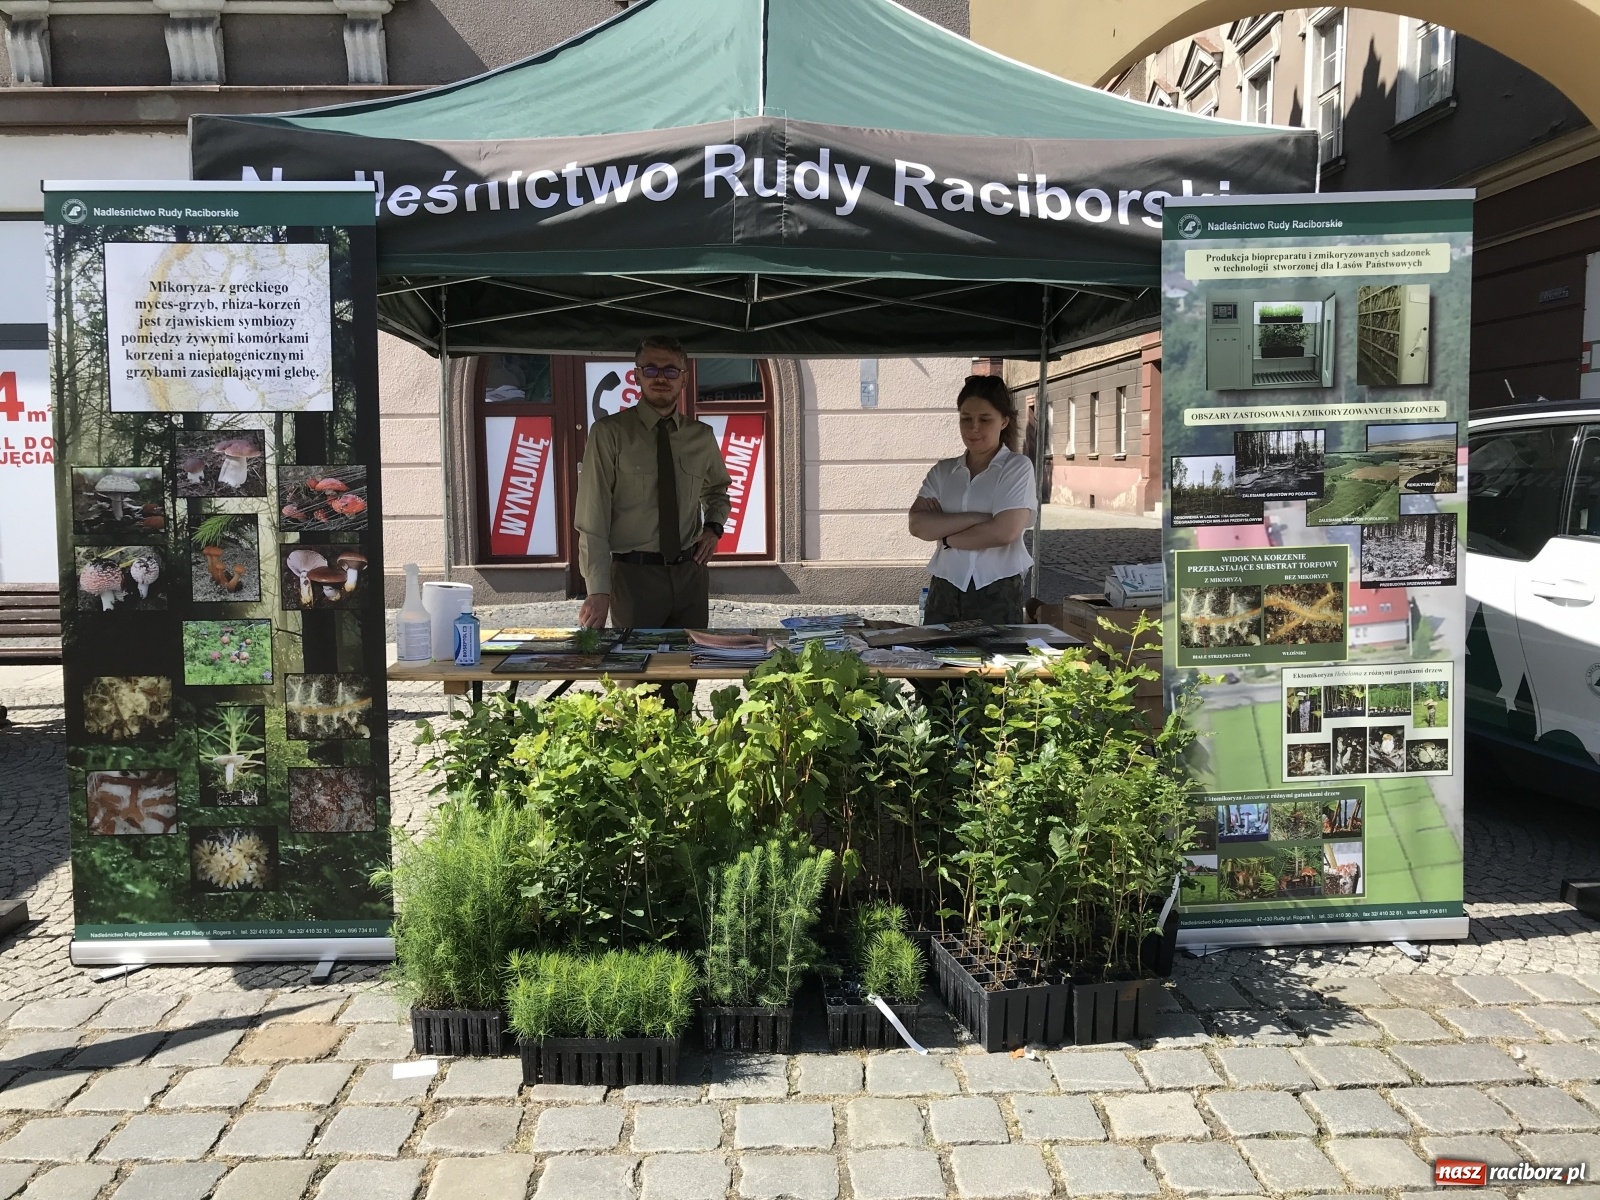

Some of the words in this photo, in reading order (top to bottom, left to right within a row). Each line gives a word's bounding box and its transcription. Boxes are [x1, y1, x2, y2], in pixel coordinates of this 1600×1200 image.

[242, 161, 679, 217] leśnictwo
[703, 144, 871, 216] Rudy
[894, 158, 1230, 229] Racibors
[93, 207, 156, 217] Nadleśnictwo
[158, 207, 182, 219] Rudy
[185, 207, 239, 217] Raciborskie
[1207, 220, 1265, 232] Nadleśnictwo
[1267, 220, 1290, 232] Rudy
[1292, 219, 1343, 229] Raciborskie
[1206, 253, 1249, 263] Produkcja
[1251, 252, 1307, 262] biopreparatu
[1308, 252, 1312, 260] i
[1313, 250, 1389, 260] zmikoryzowanych
[1391, 248, 1431, 258] sadzonek
[1223, 263, 1269, 274] technologii
[1273, 262, 1318, 272] stworzonej
[1320, 262, 1334, 270] dla
[1336, 260, 1363, 270] Lasów
[1365, 259, 1423, 270] Państwowych
[150, 281, 216, 295] Mikoryza-
[219, 284, 226, 293] z
[229, 281, 289, 296] greckiego
[135, 298, 218, 313] myces-grzyb,
[222, 298, 301, 310] rhiza-korzeń
[138, 315, 161, 330] jest
[165, 315, 235, 330] zjawiskiem
[238, 315, 296, 330] symbiozy
[121, 332, 182, 346] pomiędzy
[186, 332, 234, 346] żywymi
[237, 332, 309, 344] komórkami
[125, 349, 173, 361] korzeni
[177, 352, 185, 361] a
[189, 349, 304, 364] niepatogenicznymi
[126, 366, 186, 380] grzybami
[190, 366, 280, 380] zasiedlającymi
[284, 366, 320, 380] glebę.
[1191, 412, 1232, 421] OBSZARY
[1233, 410, 1301, 419] ZASTOSOWANIA
[1302, 407, 1392, 418] ZMIKORYZOWANYCH
[1393, 405, 1440, 415] SADZONEK
[24, 436, 54, 450] DO
[499, 433, 550, 536] WYNAJMĘ
[1264, 554, 1307, 562] KORZENIE
[1187, 564, 1255, 573] PRZERASTAJĄCE
[1256, 563, 1298, 571] SUBSTRAT
[1298, 561, 1339, 569] TORFOWY
[1394, 668, 1424, 676] gatunkami
